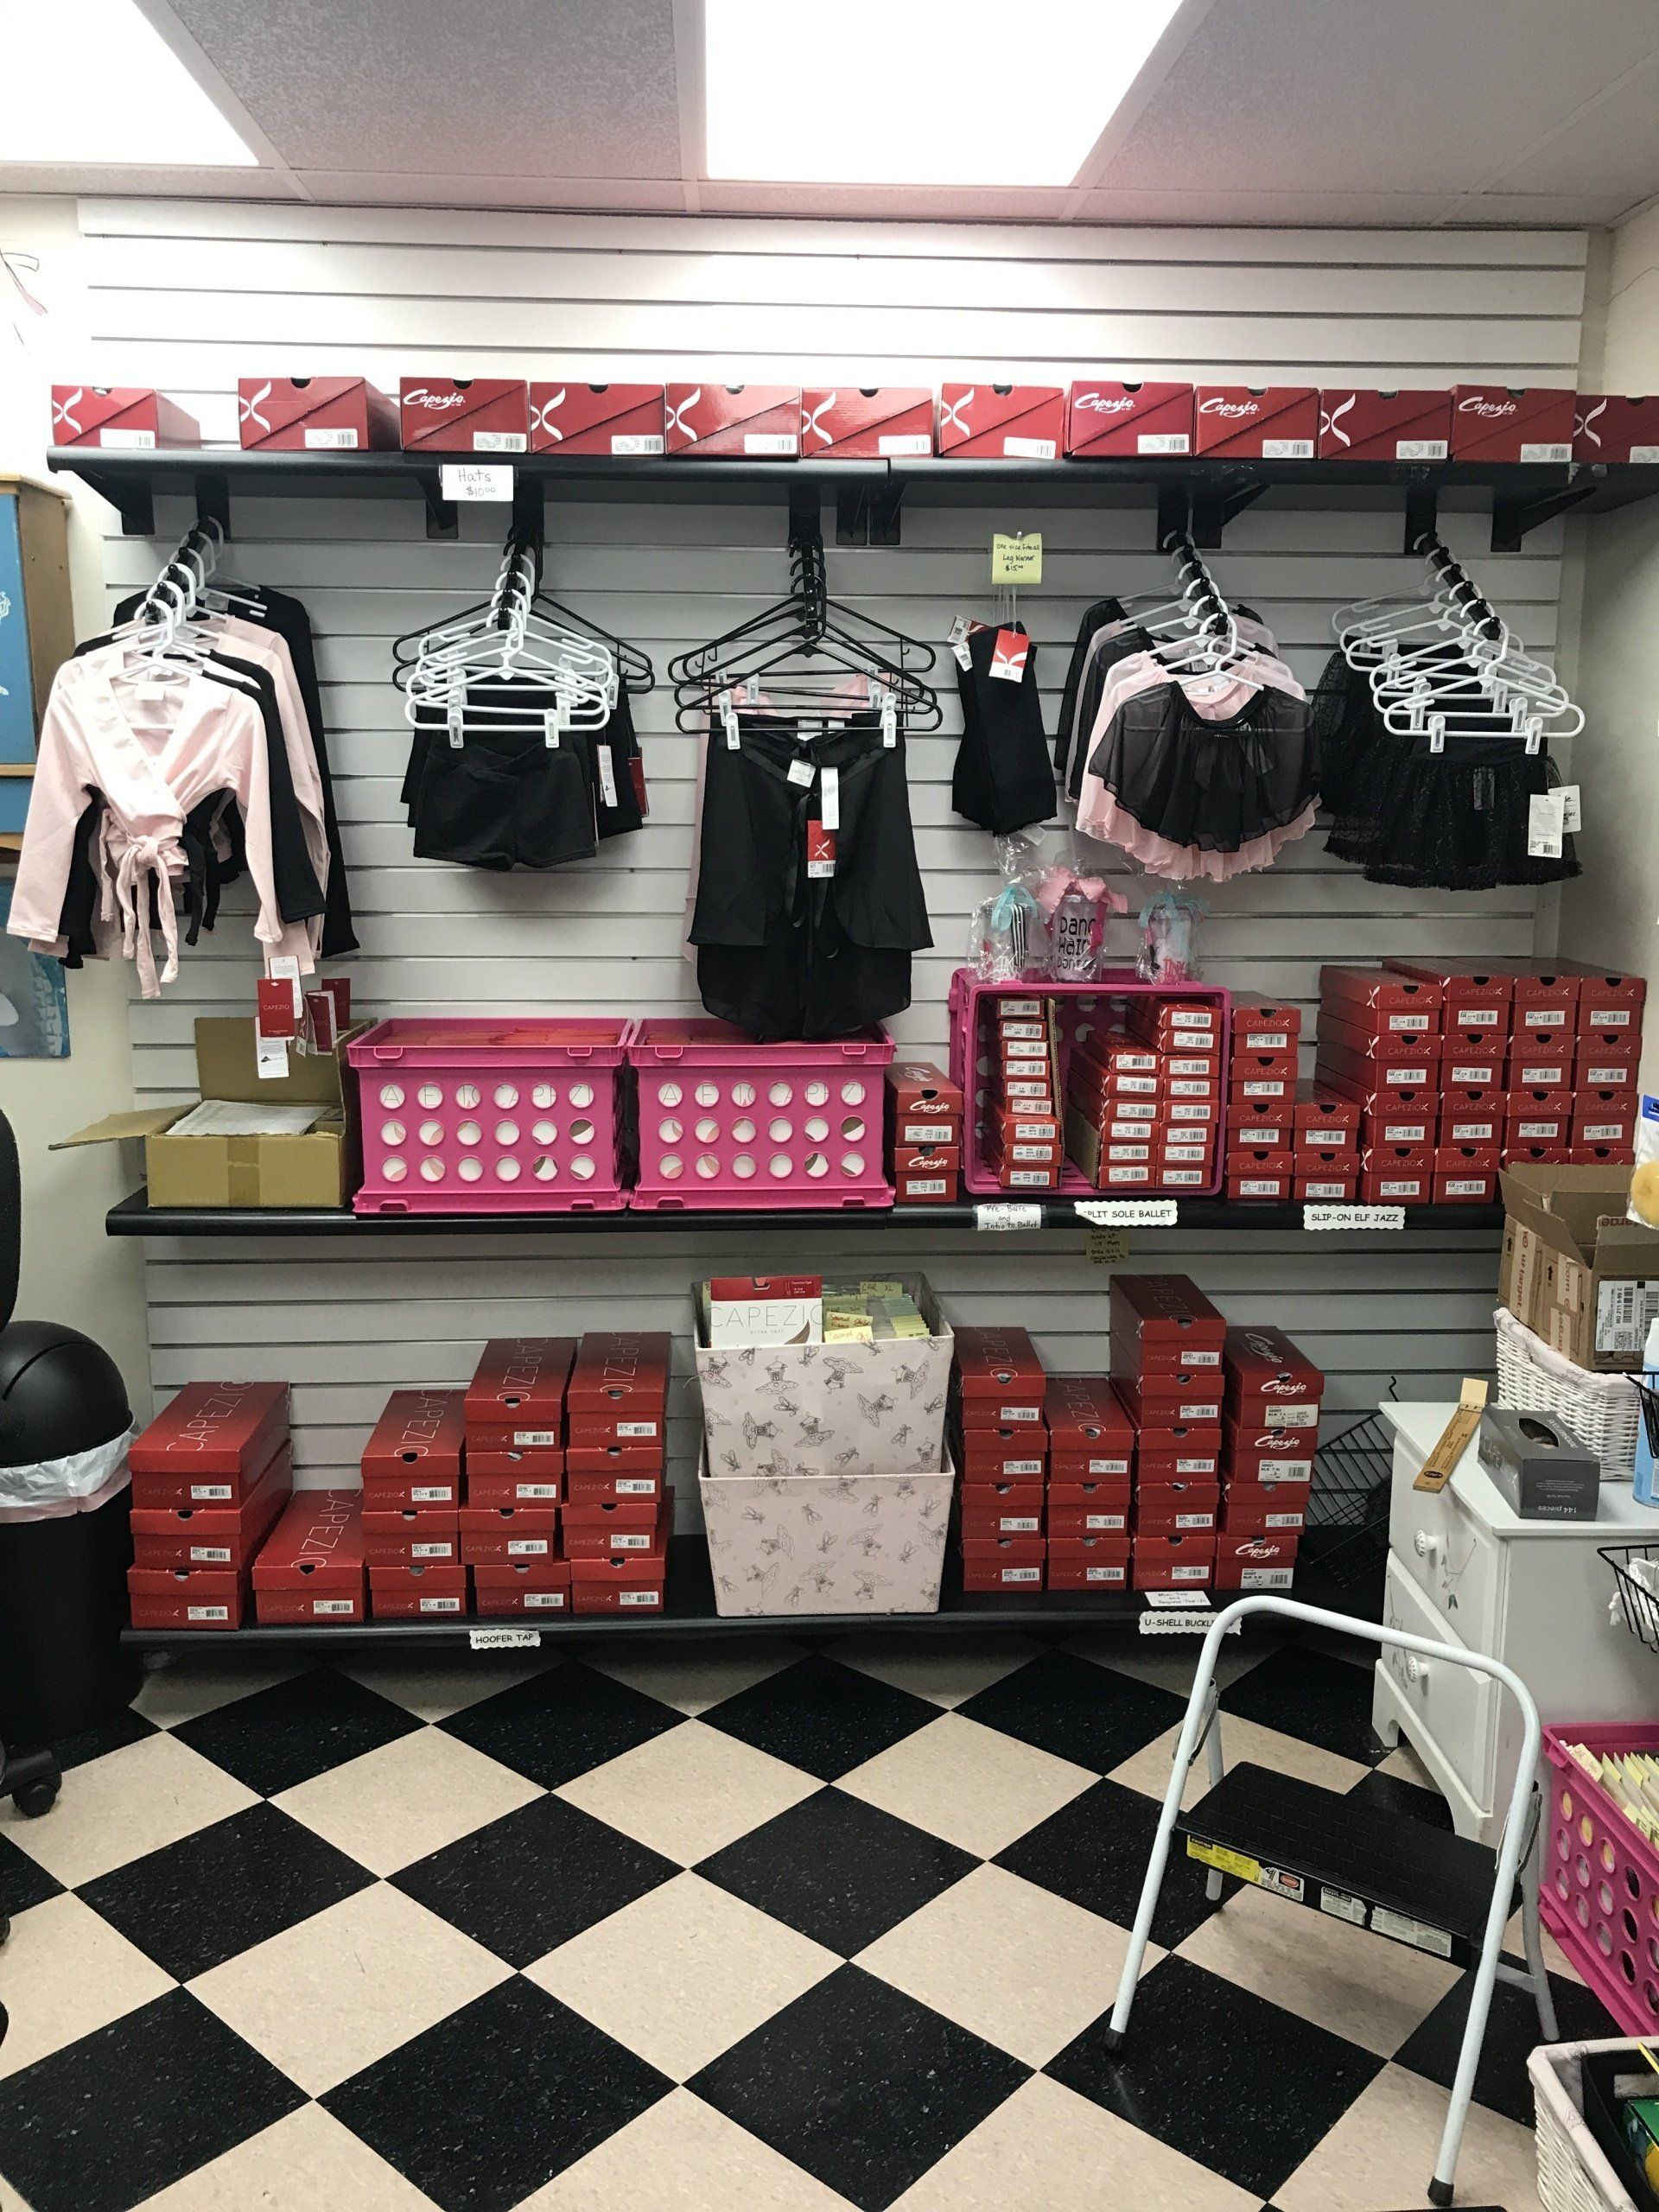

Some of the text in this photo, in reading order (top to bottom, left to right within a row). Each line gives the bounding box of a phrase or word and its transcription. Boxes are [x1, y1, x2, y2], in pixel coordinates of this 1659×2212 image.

[404, 389, 465, 410] Capezio
[1074, 392, 1134, 413] Capezio
[1199, 397, 1258, 417] Capezio
[1459, 397, 1516, 417] Capezio
[458, 469, 492, 483] Hats
[1003, 554, 1014, 564] Leg
[910, 1100, 950, 1115] Capezio
[908, 1156, 948, 1170] Capezio
[1312, 1213, 1351, 1222] SLIP-ON
[1354, 1213, 1370, 1222] ELF
[1261, 1380, 1306, 1395] Capezio
[1255, 1434, 1300, 1450] Capezio
[1236, 1543, 1281, 1559] Capezio
[476, 1635, 512, 1643] HOOFER
